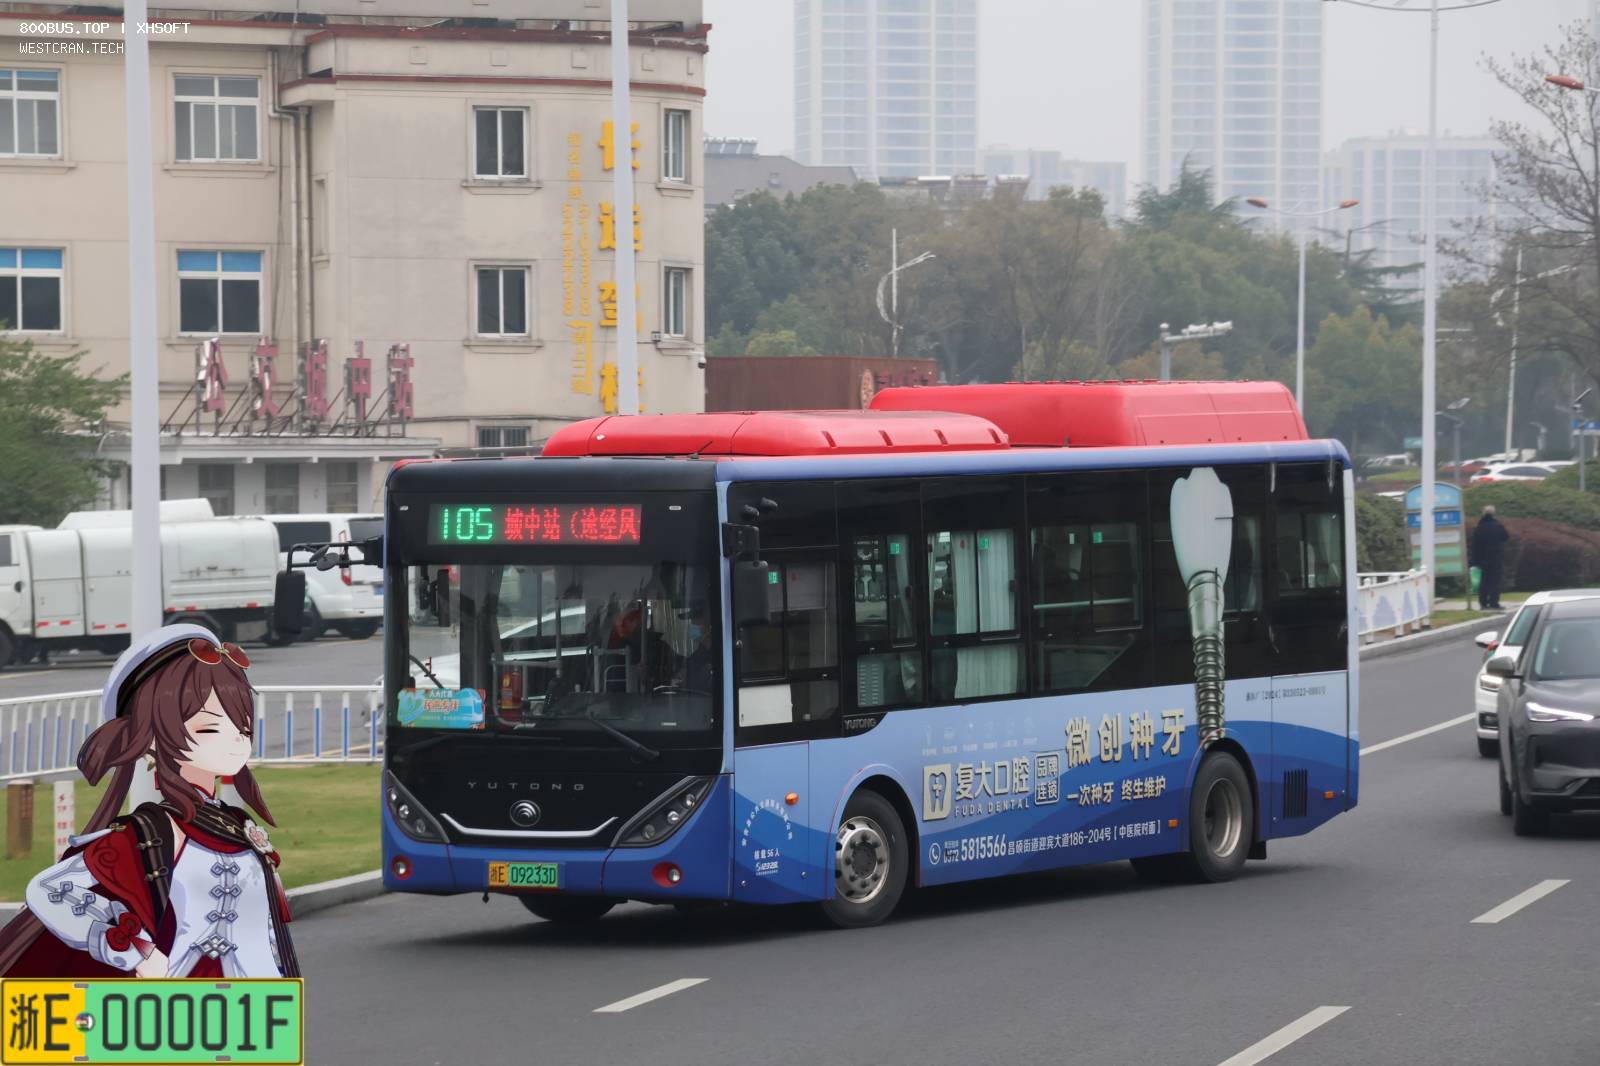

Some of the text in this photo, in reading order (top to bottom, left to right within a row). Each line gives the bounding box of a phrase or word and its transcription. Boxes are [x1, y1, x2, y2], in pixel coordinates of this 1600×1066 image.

[440, 507, 493, 540] 105
[844, 717, 877, 730] YUTONG
[1064, 708, 1185, 768] 微创种牙
[467, 781, 584, 792] YUTONG
[954, 756, 1030, 801] 复大口腔
[1067, 775, 1167, 806] 一次种牙 终生维护
[955, 798, 1030, 818] FUDA DENTAL
[961, 834, 1006, 862] 5815566
[511, 865, 557, 884] 09233D
